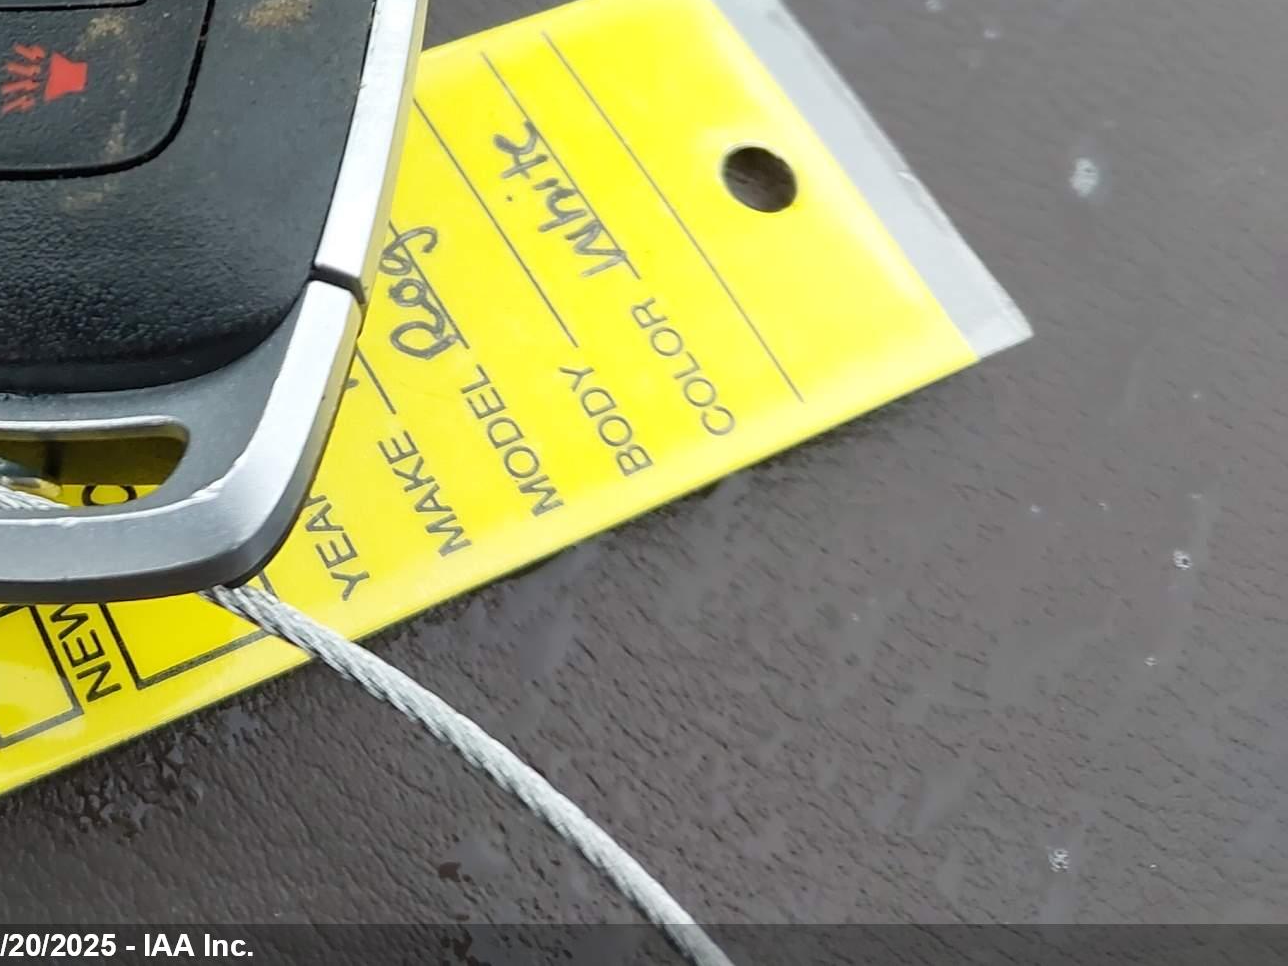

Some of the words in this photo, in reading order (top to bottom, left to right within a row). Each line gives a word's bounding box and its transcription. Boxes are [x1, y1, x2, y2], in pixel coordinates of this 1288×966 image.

[559, 365, 654, 477] BODY
[631, 298, 736, 436] COLOR
[378, 430, 472, 556] MAKE
[460, 364, 565, 517] MODEL
